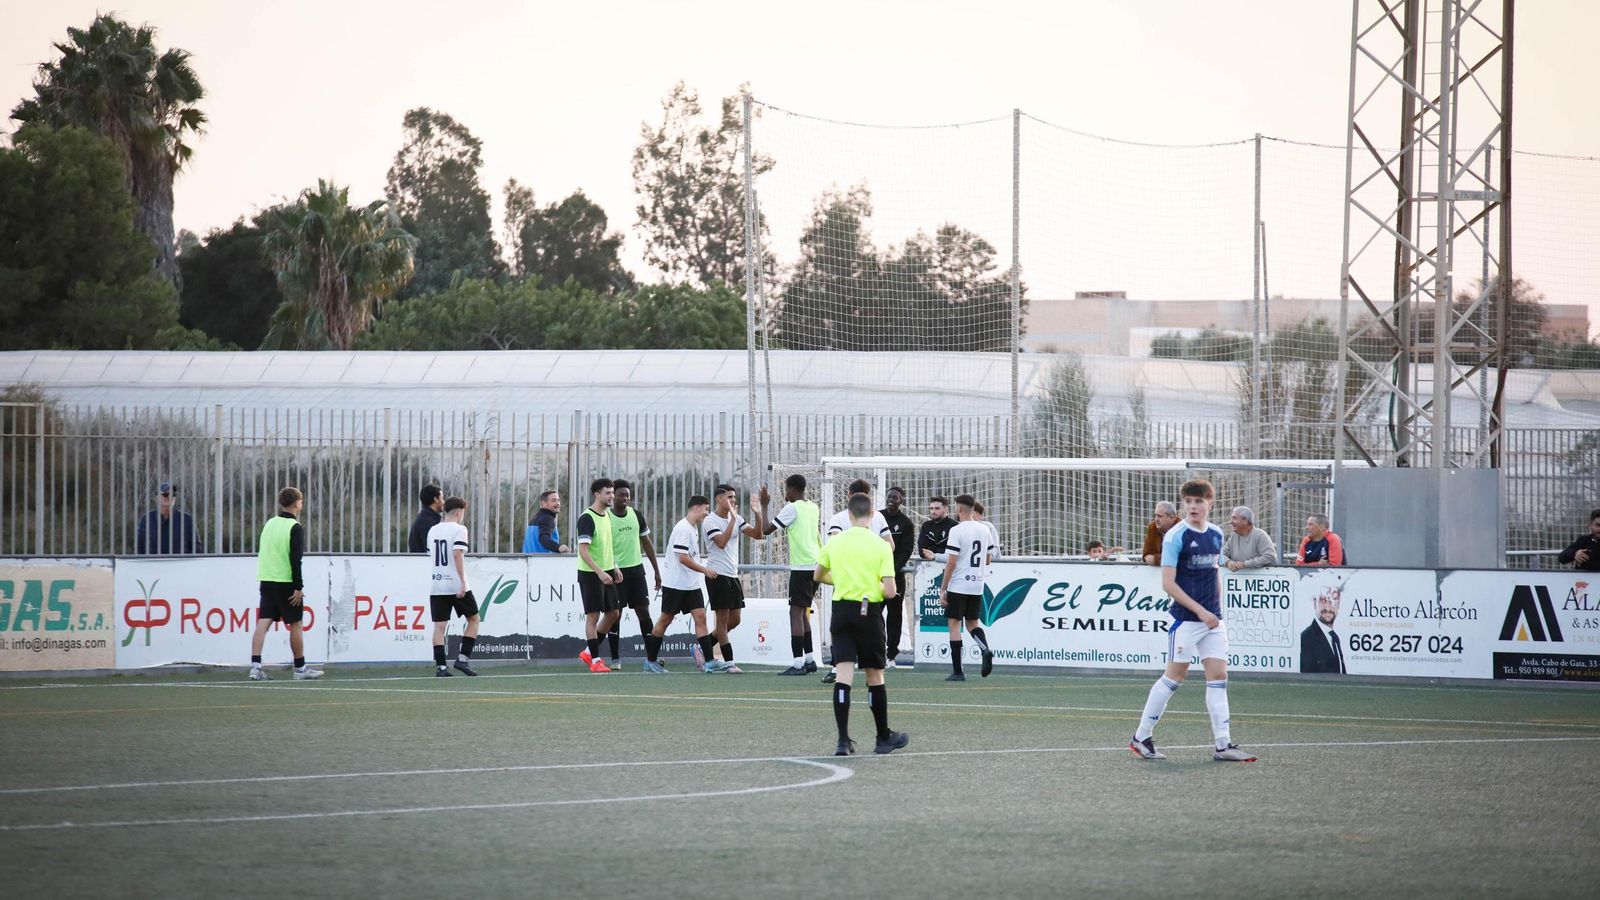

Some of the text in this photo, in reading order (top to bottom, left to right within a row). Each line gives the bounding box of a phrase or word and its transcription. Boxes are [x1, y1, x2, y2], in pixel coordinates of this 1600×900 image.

[434, 539, 448, 567] 10
[970, 540, 981, 567] 2
[1227, 579, 1290, 592] EL MEJOR
[924, 598, 941, 606] nue
[1042, 582, 1171, 613] El Plan
[1227, 594, 1290, 609] INJERTO
[180, 598, 315, 634] ROMO
[354, 595, 425, 630] PÁEZ
[1350, 598, 1477, 620] Alberto Alarcón
[1042, 616, 1168, 632] SEMILLER
[1227, 610, 1291, 628] PARA TU
[1572, 617, 1581, 628] &
[1227, 627, 1290, 643] COSECHA
[12, 638, 106, 652] info@dinagas.com
[1350, 634, 1463, 654] 662 257 024
[991, 647, 1151, 664] www.elplantelsemilleros.com
[1243, 655, 1257, 667] 33
[1261, 655, 1274, 668] 01
[1279, 656, 1292, 668] 01
[1522, 658, 1540, 666] Avda.
[1542, 659, 1559, 667] Cabo
[1561, 659, 1569, 667] de
[1519, 667, 1532, 675] 950
